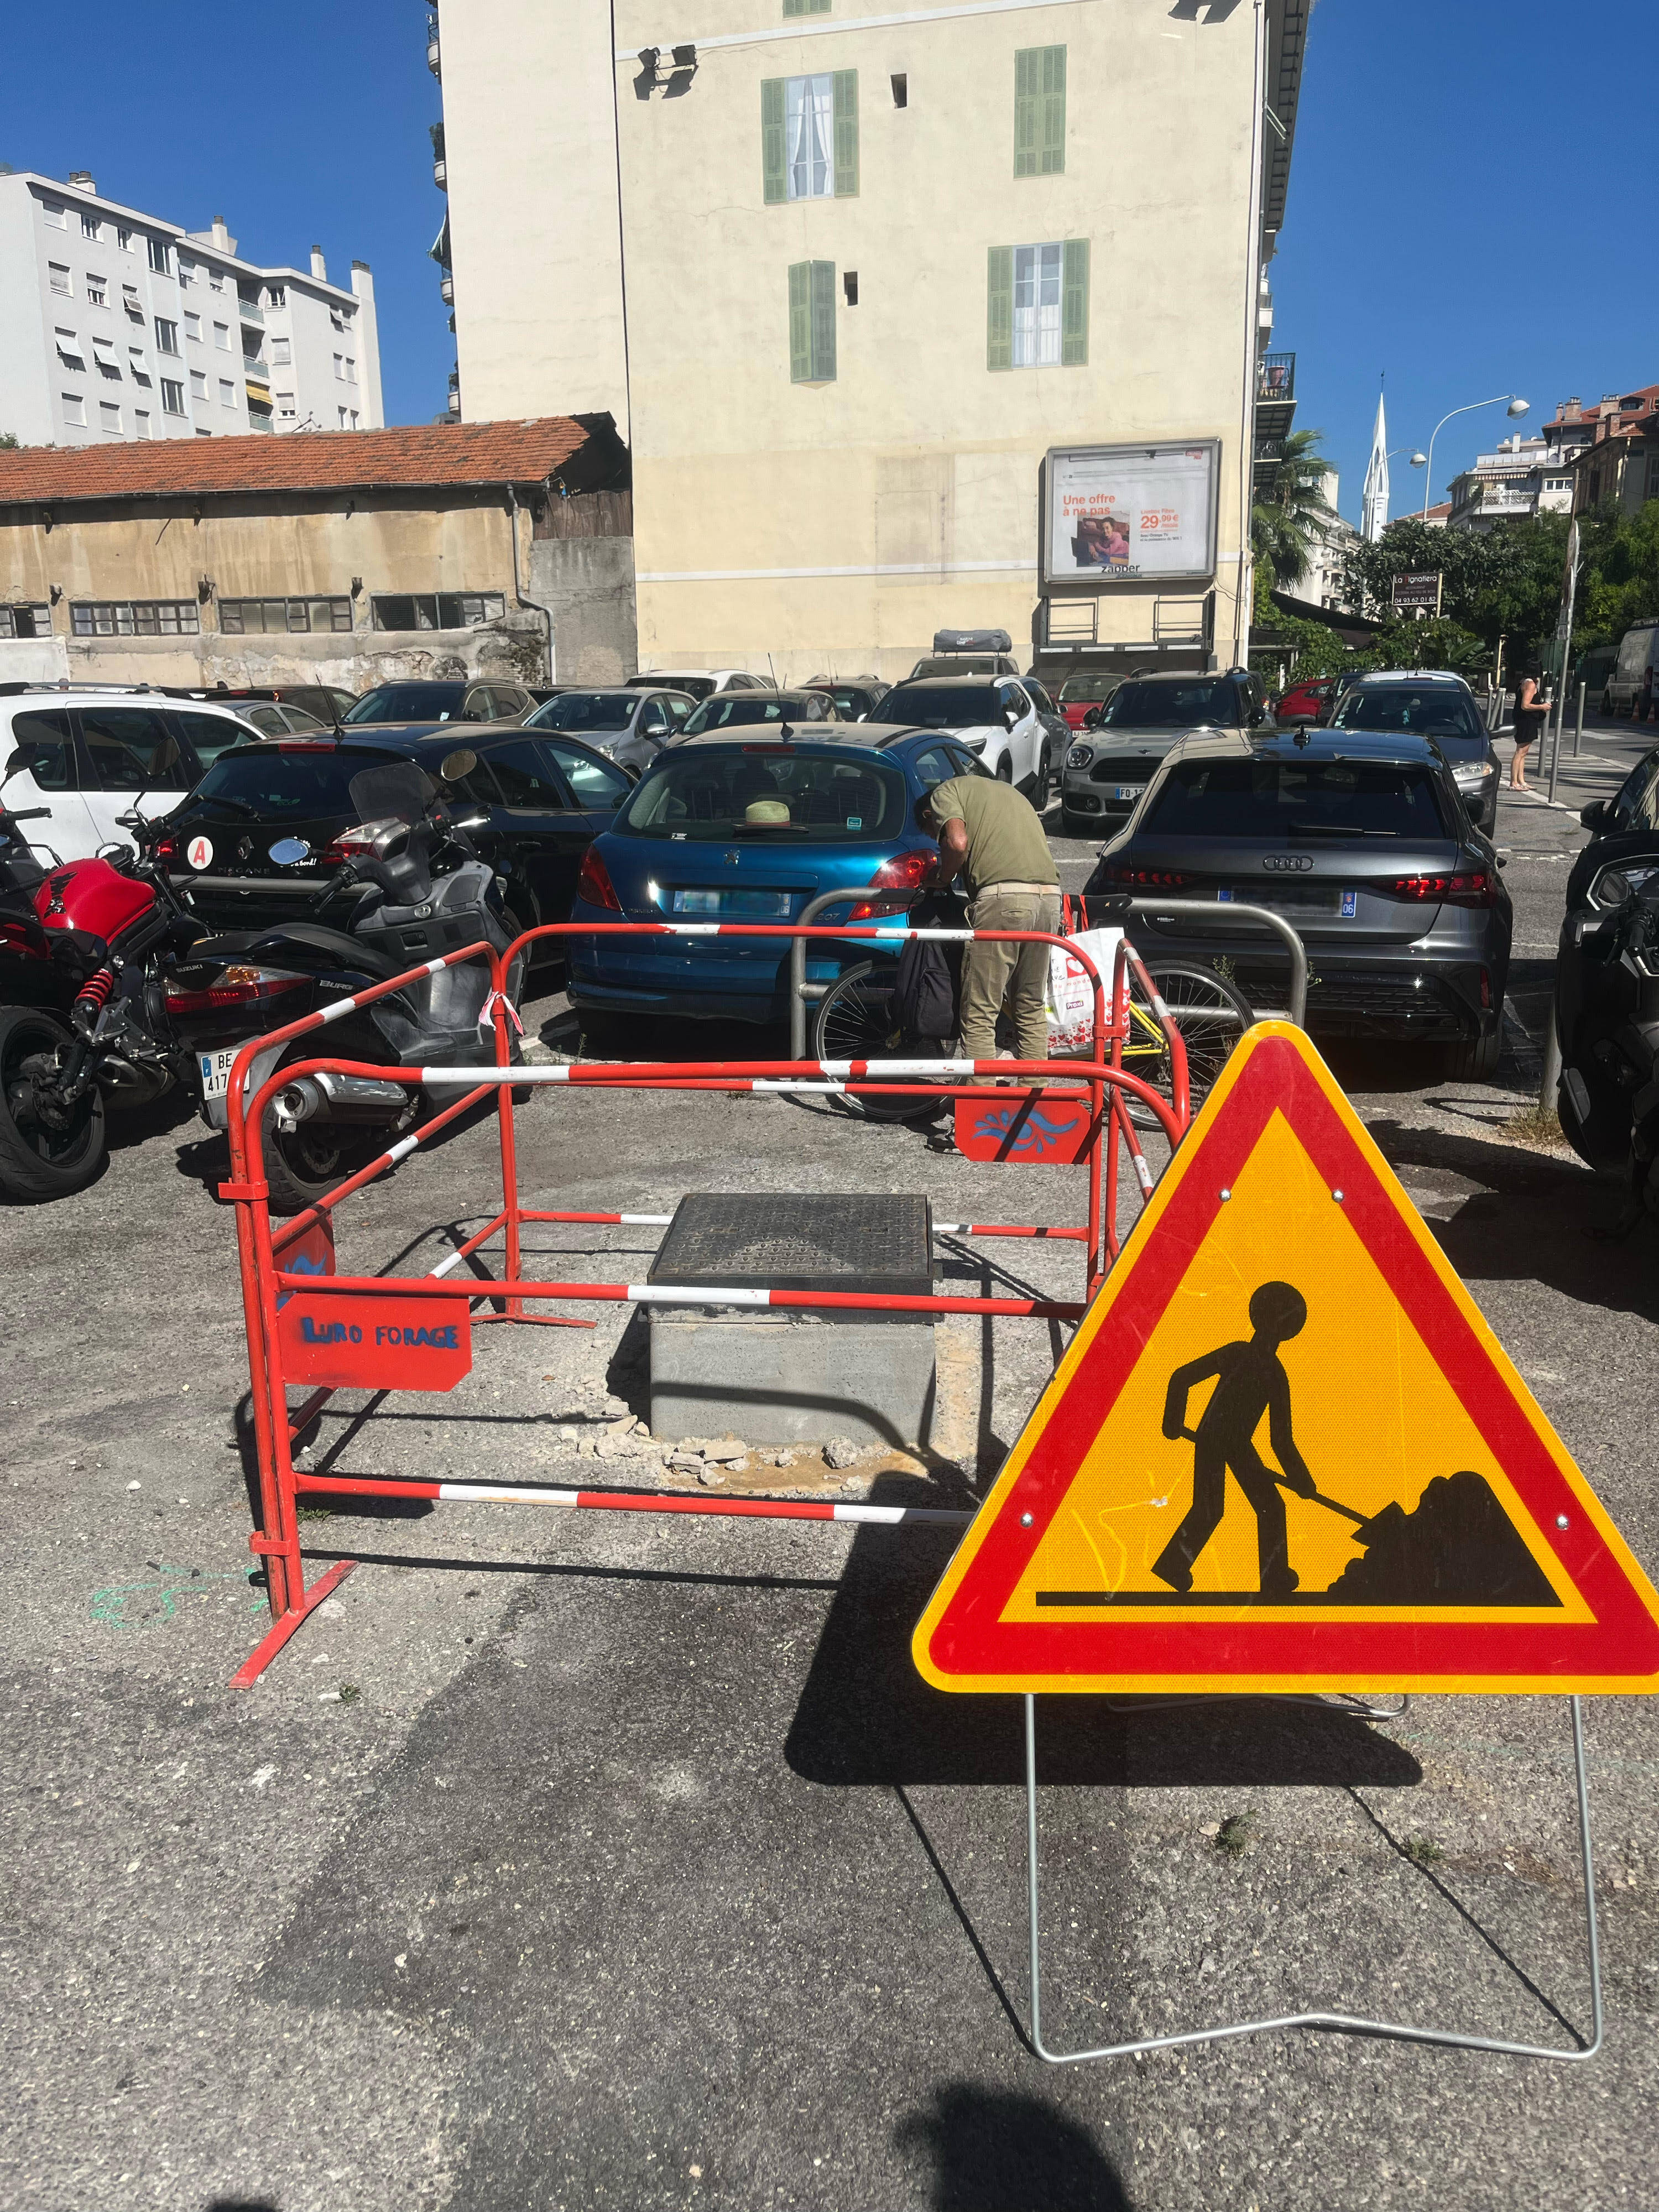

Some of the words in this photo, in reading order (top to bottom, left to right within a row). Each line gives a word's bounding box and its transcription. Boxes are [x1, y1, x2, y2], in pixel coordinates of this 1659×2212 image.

[1063, 495, 1085, 504] Une
[1089, 494, 1115, 504] offre
[1090, 507, 1110, 518] pas
[194, 841, 206, 864] A
[1343, 904, 1354, 914] 06
[176, 964, 204, 973] SUZUKI
[1067, 1000, 1083, 1009] Proxi
[218, 1053, 232, 1070] BE
[208, 1073, 227, 1092] 417
[375, 1325, 459, 1349] FORAGE
